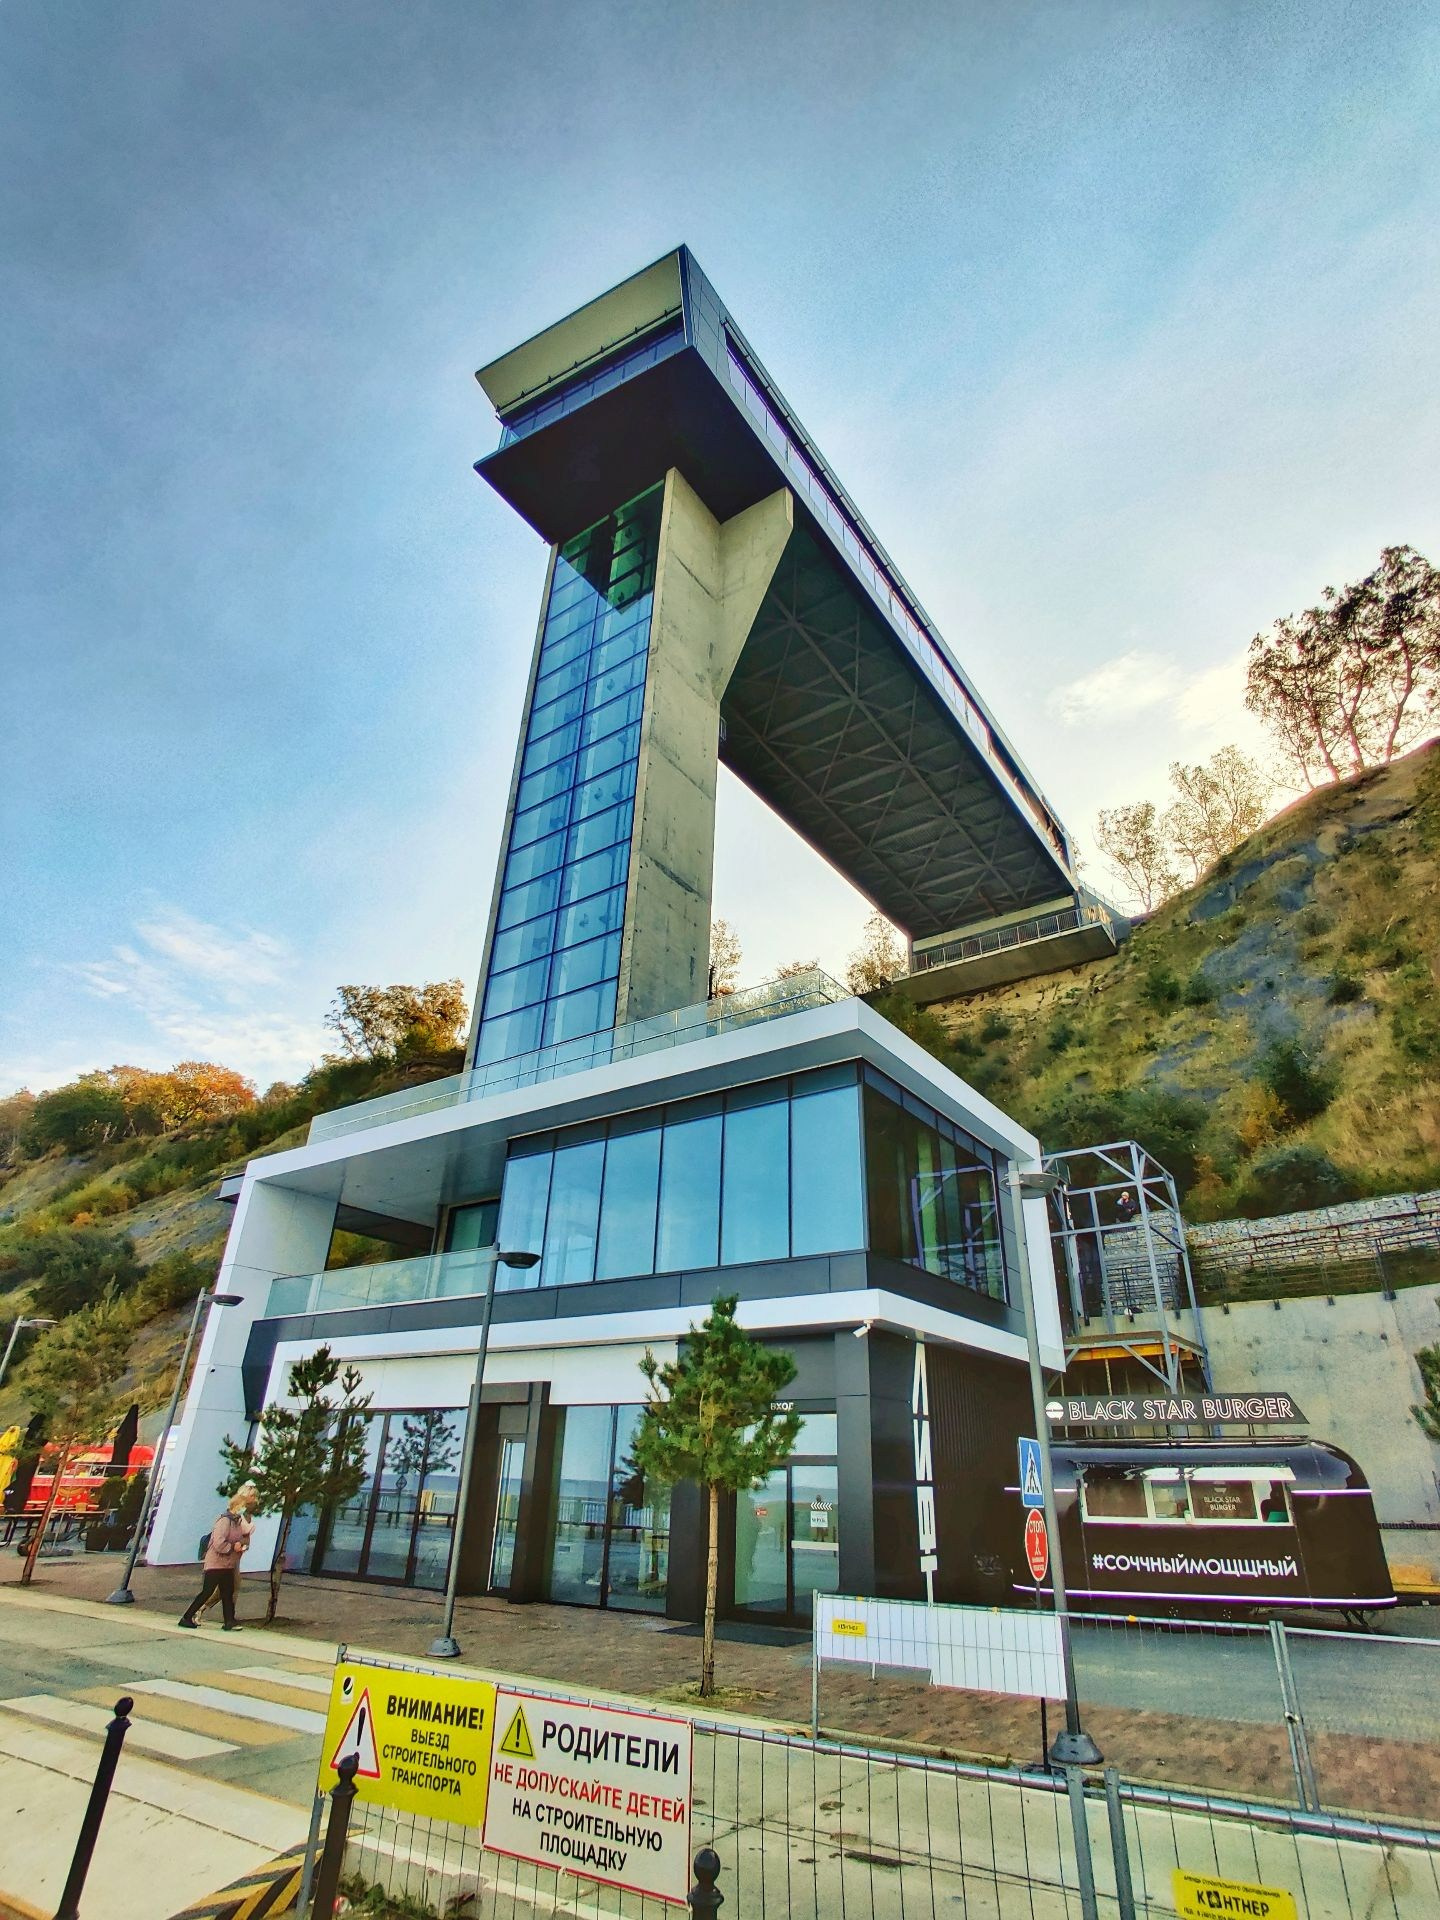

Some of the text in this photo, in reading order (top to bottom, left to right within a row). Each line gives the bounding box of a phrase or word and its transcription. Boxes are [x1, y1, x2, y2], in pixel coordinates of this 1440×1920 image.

[1068, 1398, 1294, 1420] BLACK STAR BURGER
[1029, 1520, 1044, 1533] СТОП
[1092, 1553, 1298, 1578] #СОЧЧНЫЙМОЩЩНЫЙ
[386, 1694, 485, 1730] ВНИМАНИЕ!
[410, 1728, 450, 1752] ВЫЕЗД
[542, 1720, 679, 1775] РОДИТЕЛИ
[382, 1744, 477, 1776] СТРОИТЕЛЬНОГО
[391, 1766, 461, 1796] ТРАНСПОРТА
[494, 1762, 685, 1825] НЕ ДОПУСКАЙТЕ ДЕТЕЙ
[512, 1797, 663, 1852] НА СТРОИТЕЛЬНУЮ
[540, 1831, 627, 1871] ПЛОЩАДКУ
